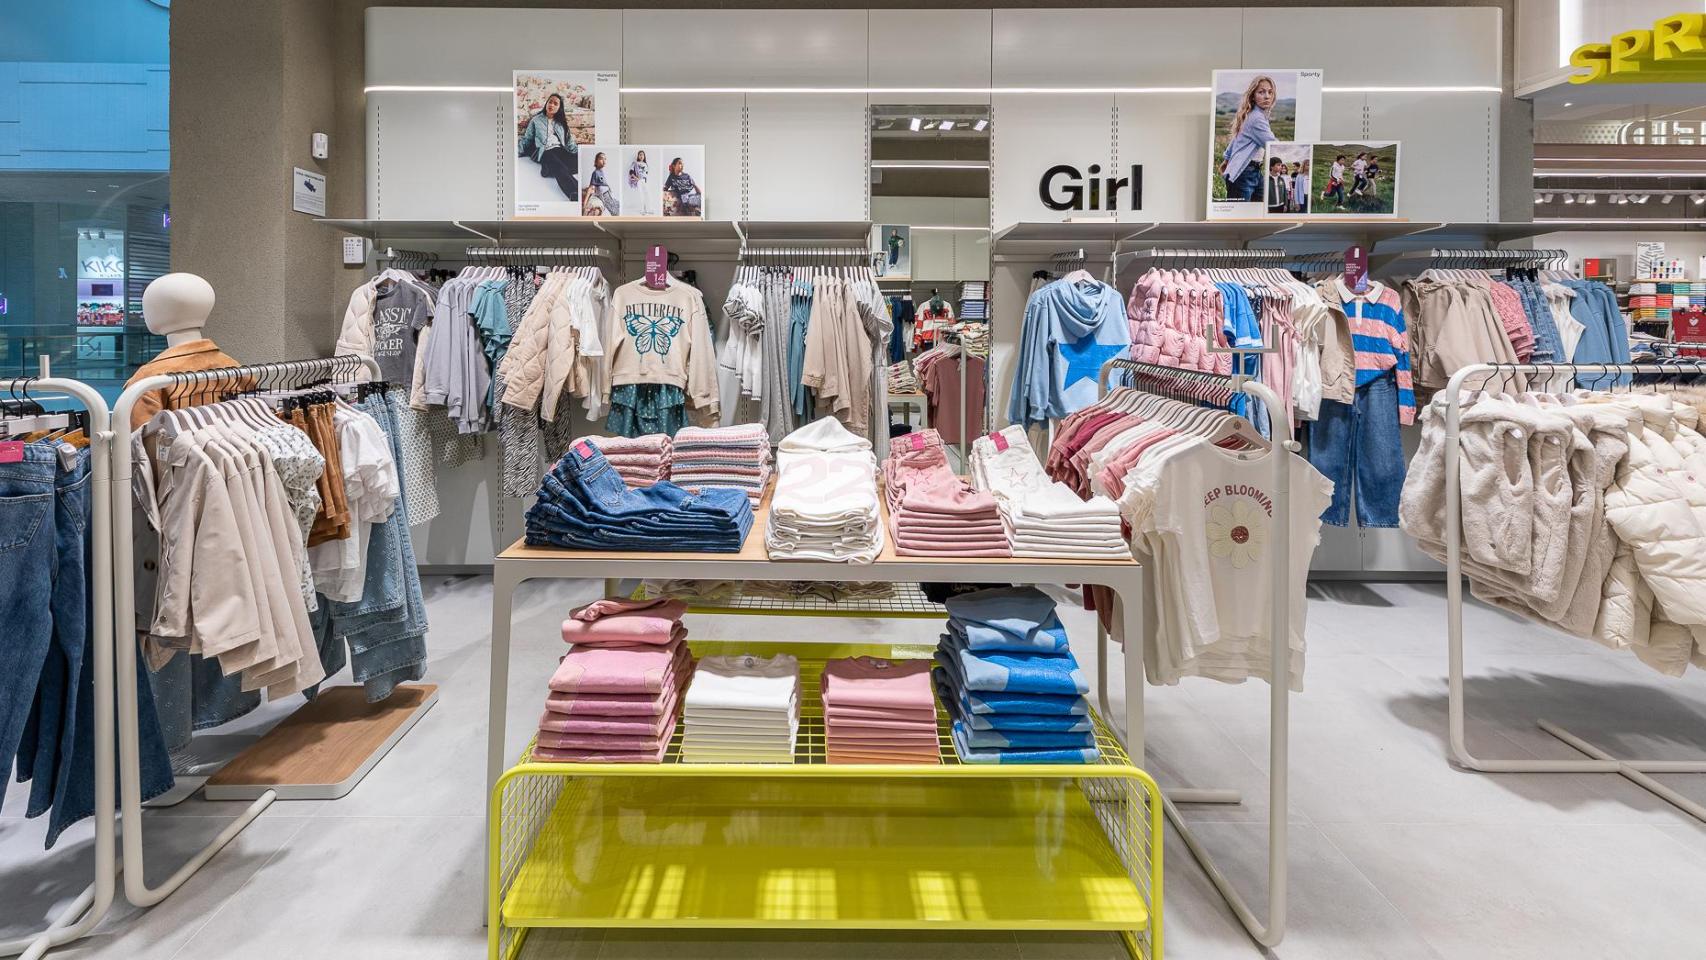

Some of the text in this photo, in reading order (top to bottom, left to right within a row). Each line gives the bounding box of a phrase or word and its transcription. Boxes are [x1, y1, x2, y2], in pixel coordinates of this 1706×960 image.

[1039, 164, 1143, 211] Girl
[654, 273, 665, 282] 14
[374, 307, 412, 326] ASSIC
[625, 302, 684, 318] BUTTERFLY
[1204, 487, 1221, 508] EEP
